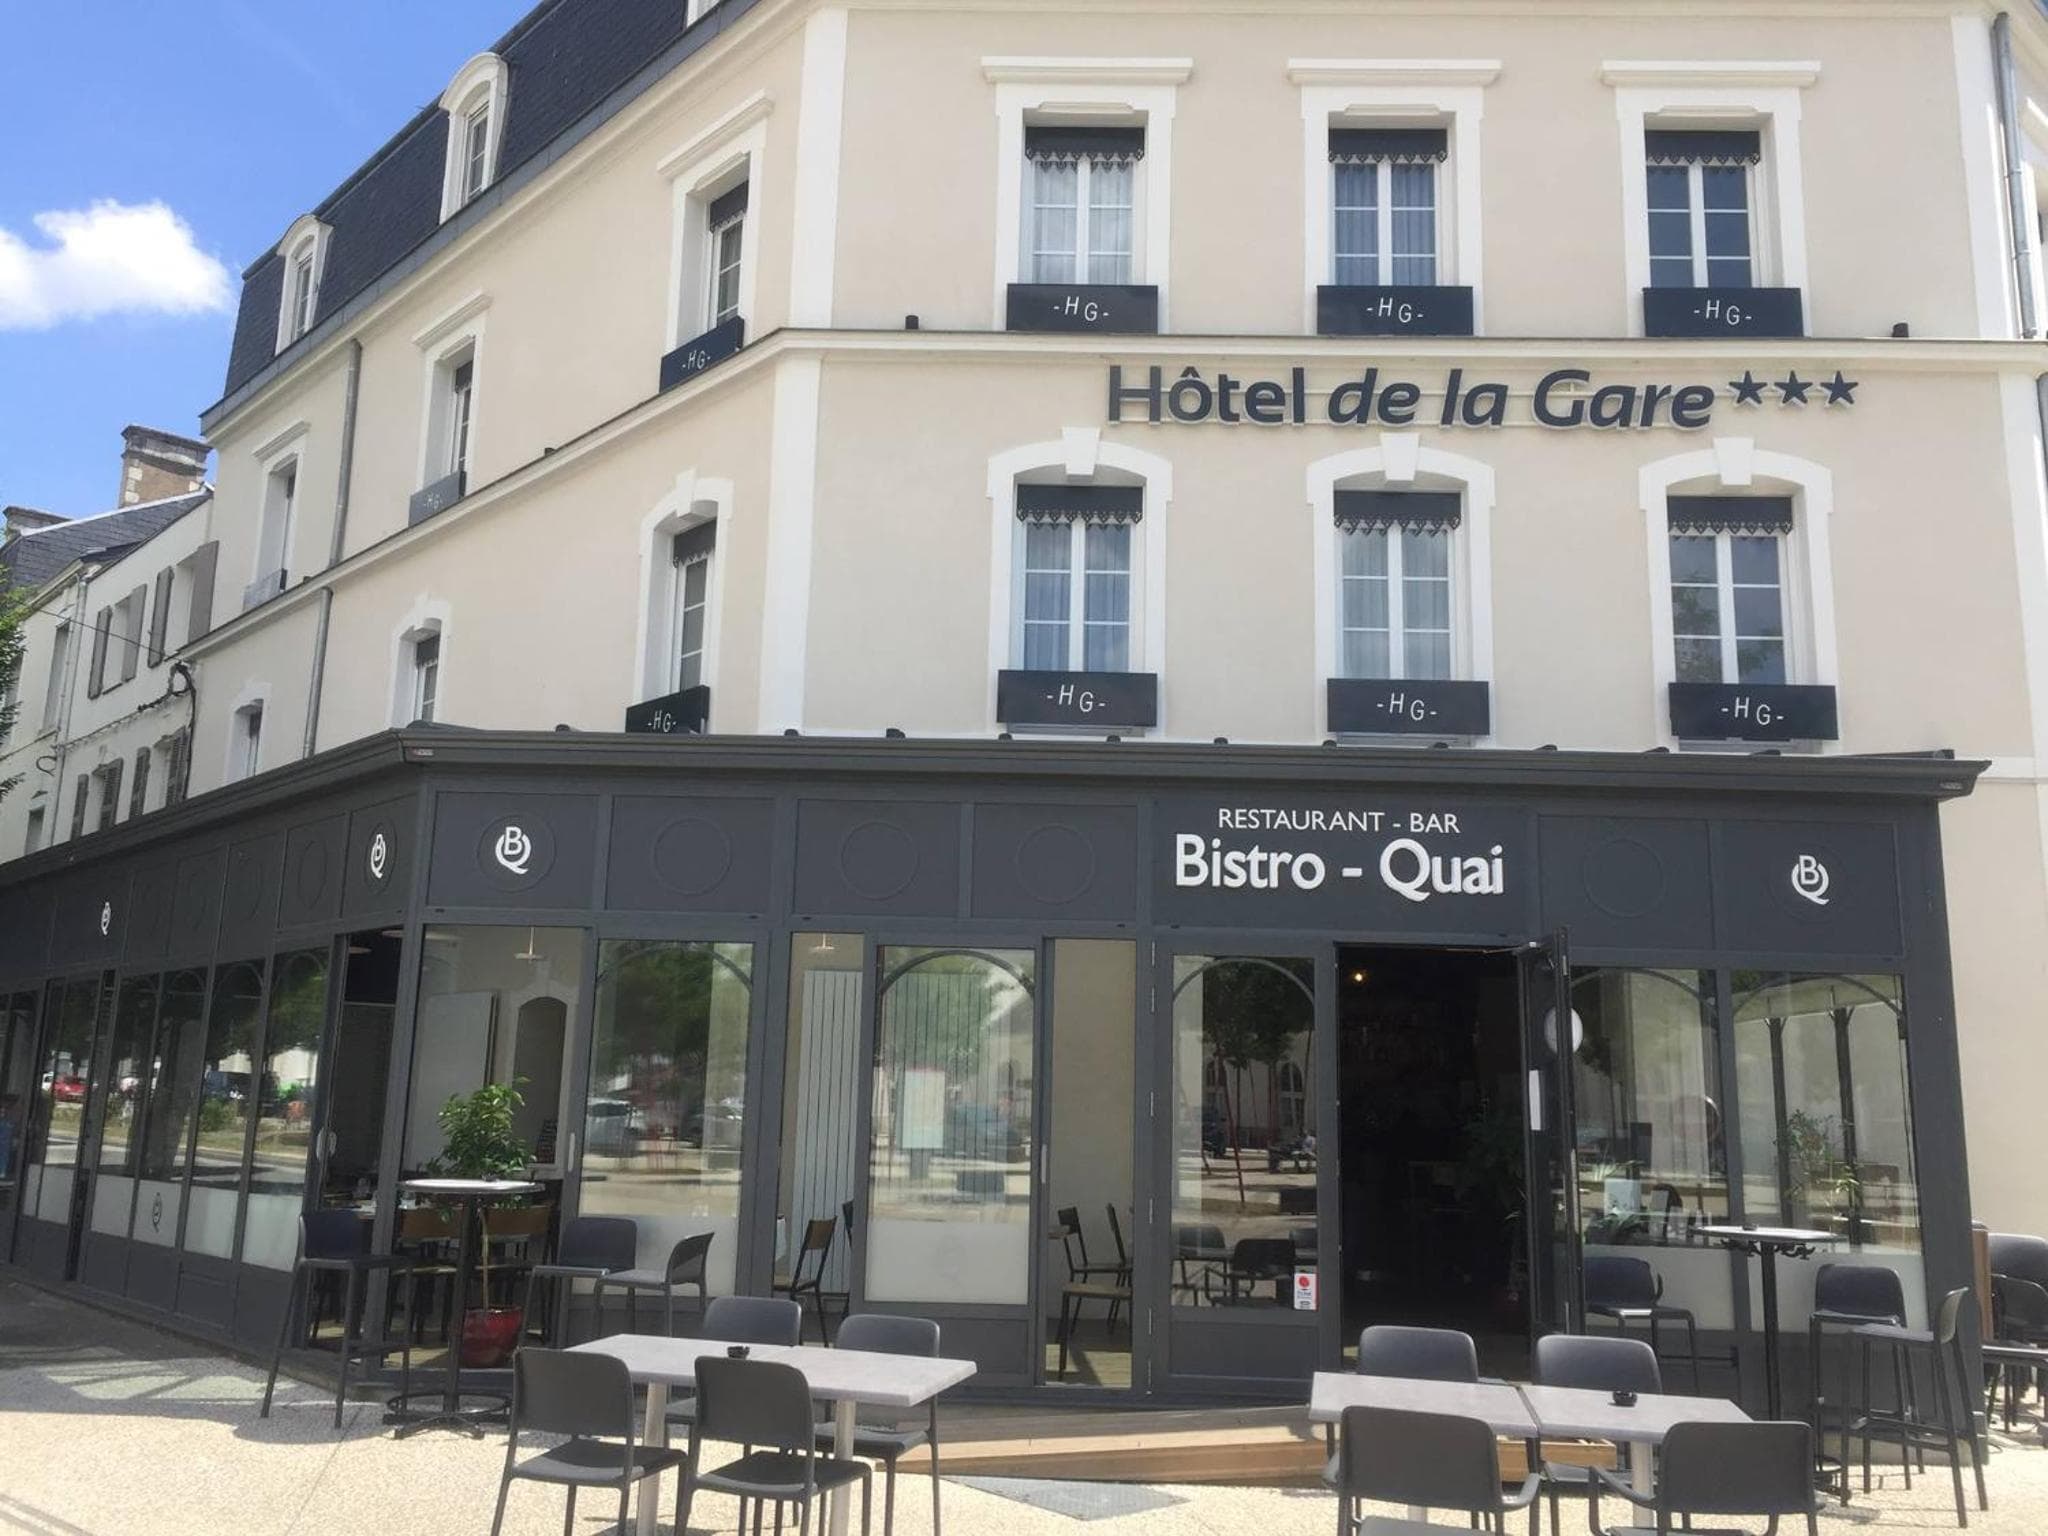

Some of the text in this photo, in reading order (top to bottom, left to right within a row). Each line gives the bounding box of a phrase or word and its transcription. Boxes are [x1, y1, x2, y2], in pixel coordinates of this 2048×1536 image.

[1107, 364, 1716, 429] Hôtel de la Gare
[1218, 808, 1385, 832] RESTAURANT
[1410, 812, 1460, 834] BAR
[1175, 833, 1327, 891] Bistro
[1378, 837, 1505, 902] Quai
